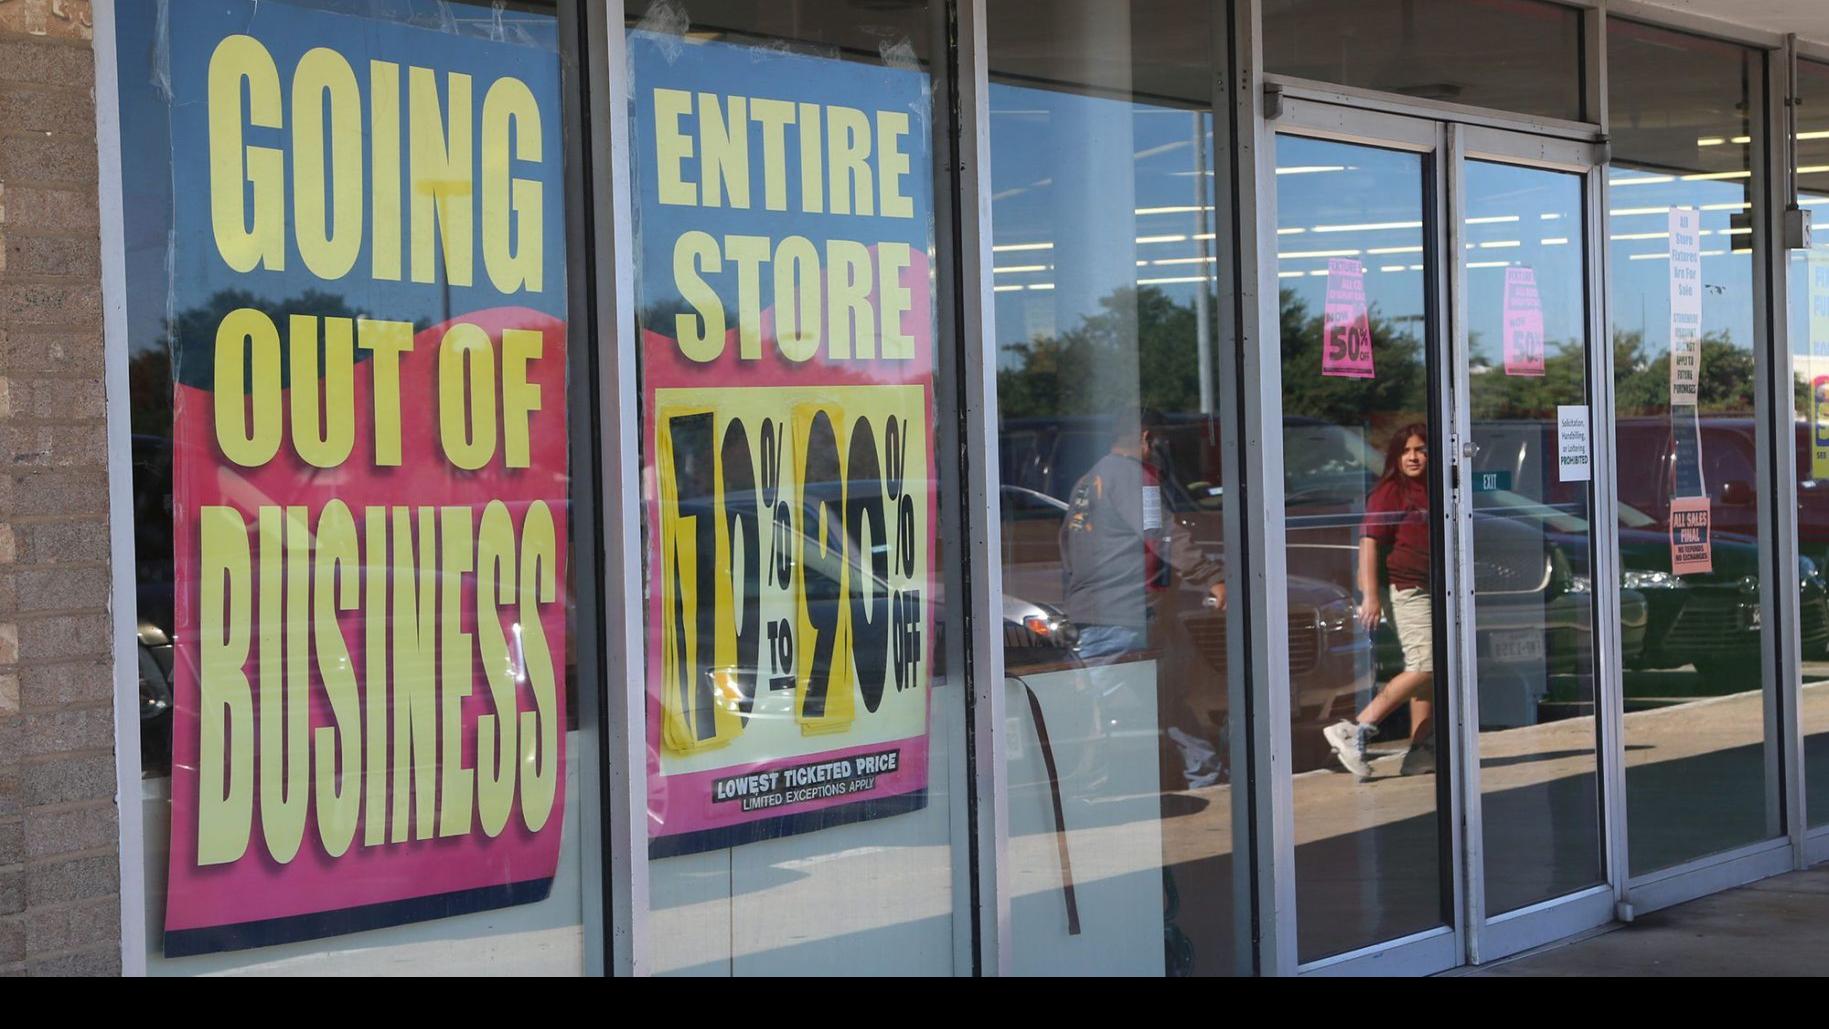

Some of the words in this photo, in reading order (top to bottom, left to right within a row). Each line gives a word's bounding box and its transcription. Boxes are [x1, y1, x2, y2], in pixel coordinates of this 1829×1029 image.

[207, 34, 543, 294] GOING
[653, 87, 914, 219] ENTIRE
[673, 230, 915, 363] STORE
[1329, 327, 1368, 361] 50%
[213, 308, 414, 468] OUT
[439, 323, 543, 470] OF
[1483, 474, 1496, 489] EXIT
[1561, 455, 1588, 465] PROHIBITED
[1674, 513, 1685, 527] ALL
[1686, 512, 1706, 527] SALES
[1681, 528, 1699, 543] FINAL
[668, 411, 793, 741] 10%
[767, 618, 793, 674] TO
[801, 409, 914, 718] 90%
[892, 589, 921, 693] OFF
[198, 498, 557, 866] BUSINESS
[717, 772, 778, 799] LOWEST
[784, 761, 851, 787] TICKETED
[856, 753, 897, 775] PRICE
[743, 794, 782, 810] LIMITED
[787, 783, 846, 804] EXCEPTIONS
[849, 778, 875, 792] APPLY
